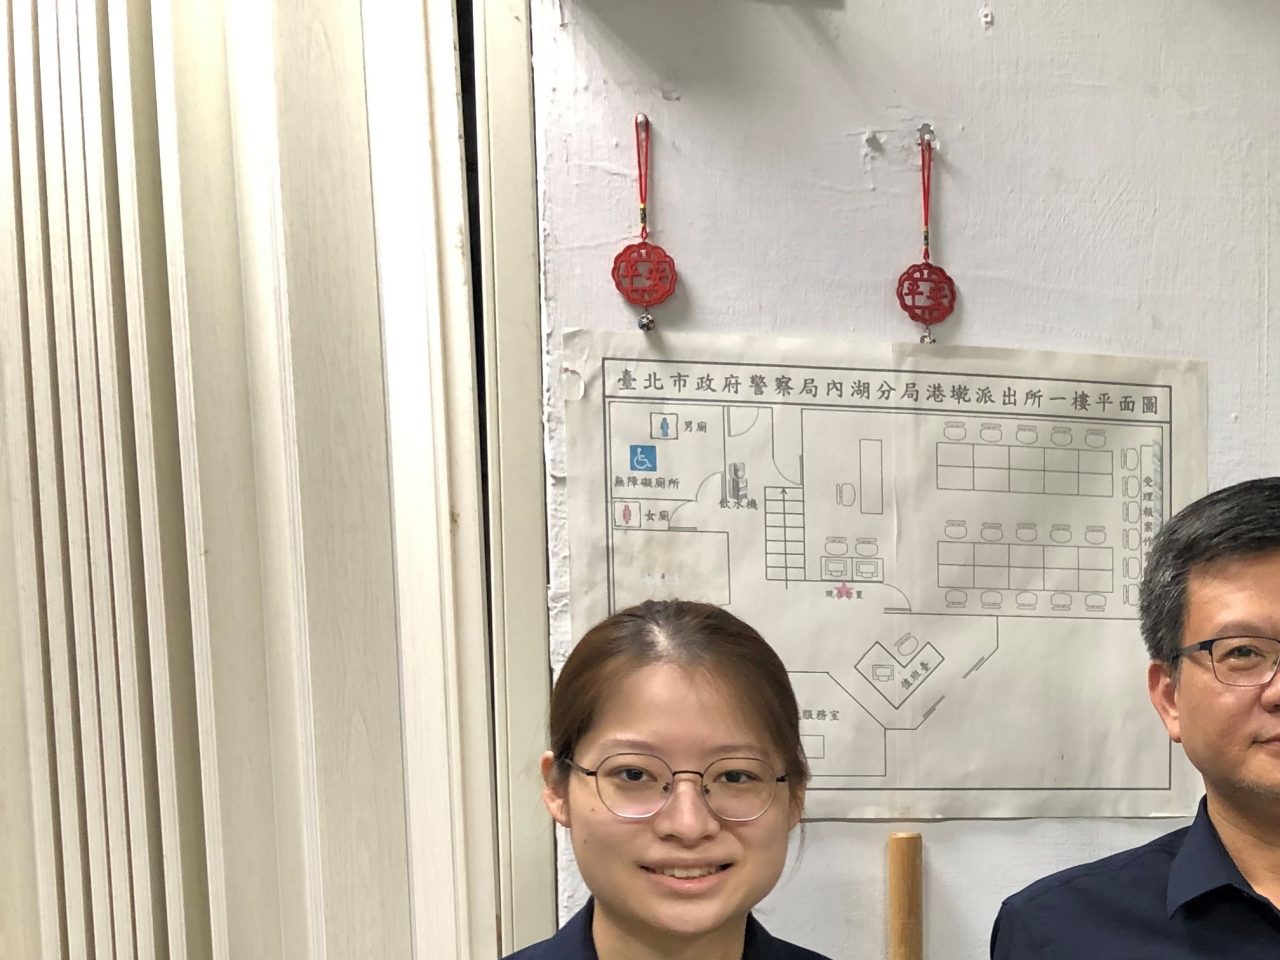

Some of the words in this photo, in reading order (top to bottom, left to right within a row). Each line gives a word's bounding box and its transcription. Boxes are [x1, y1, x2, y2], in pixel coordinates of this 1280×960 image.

[617, 368, 1159, 415] 臺北市政府警察局內湖分局港墘派出所一樓平面圖
[1143, 475, 1154, 556] 受理報案作
[800, 709, 840, 721] 服務室
